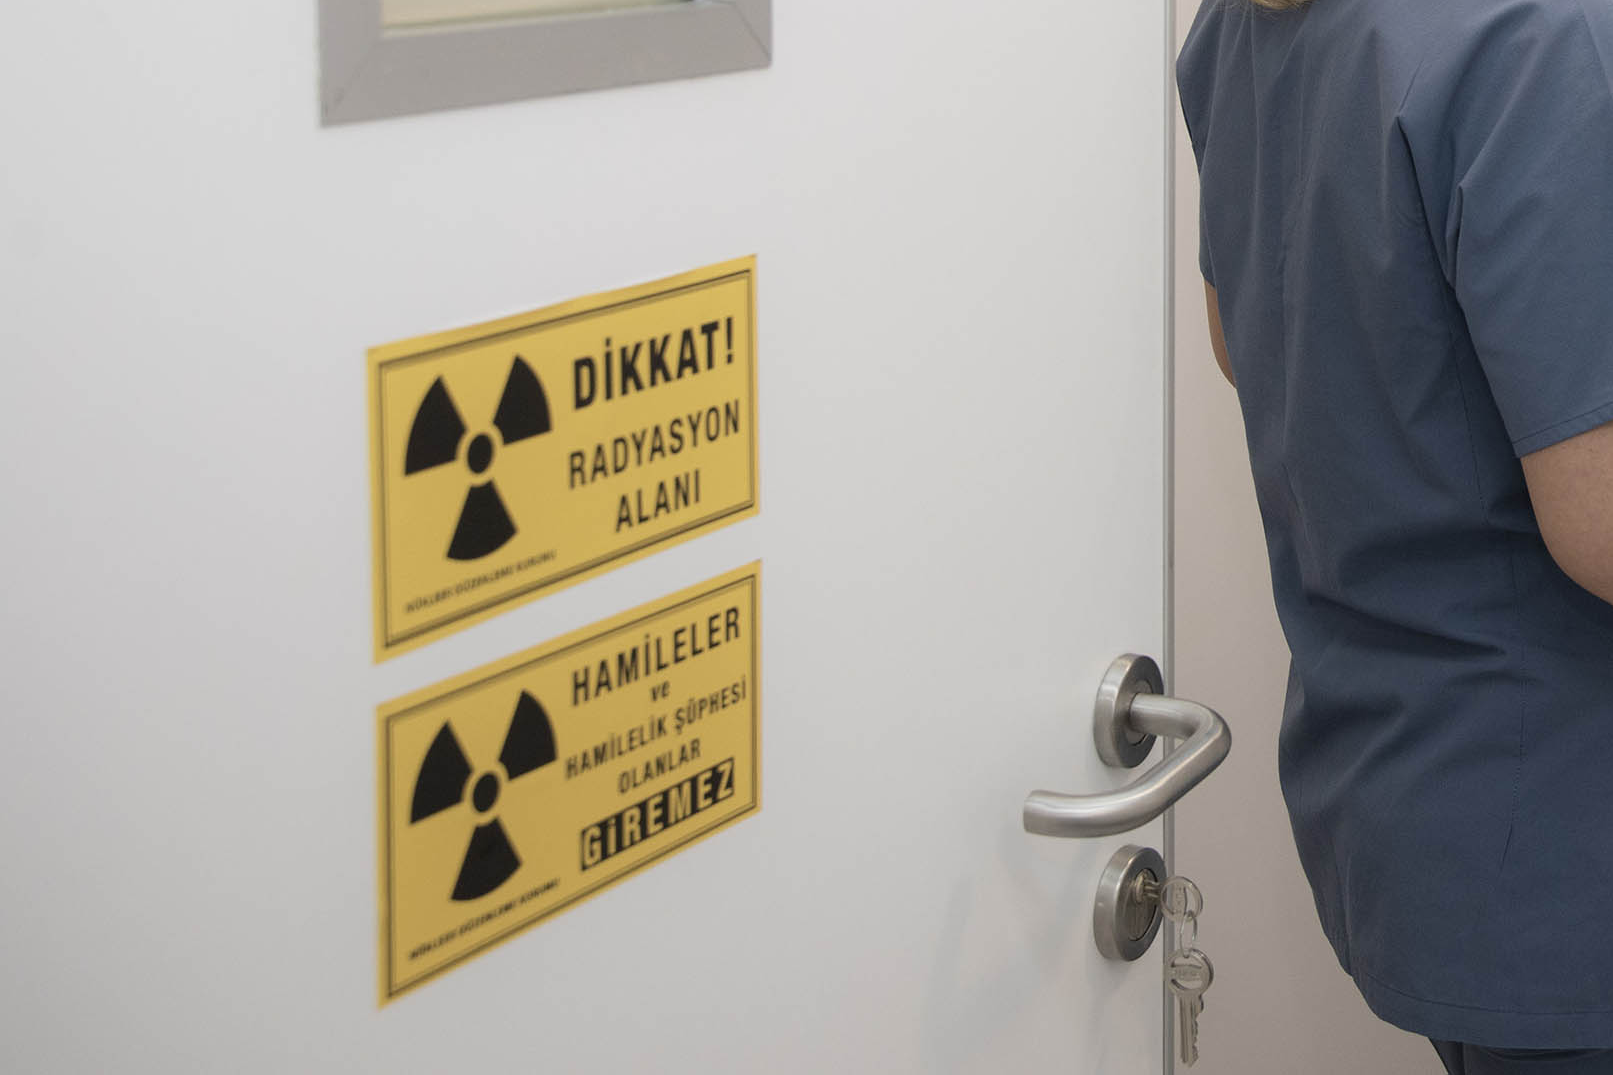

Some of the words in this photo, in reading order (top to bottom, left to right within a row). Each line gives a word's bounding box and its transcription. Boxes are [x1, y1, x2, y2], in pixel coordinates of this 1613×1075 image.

[574, 317, 733, 410] DİKKAT!
[569, 399, 740, 490] RADYASYON
[615, 469, 701, 533] ALANI
[572, 606, 740, 707] HAMİLELER
[650, 680, 671, 702] ve
[565, 716, 667, 780] HAMİLELİK
[674, 674, 747, 735] ŞÜPHESİ
[617, 737, 701, 794] OLANLAR
[581, 760, 735, 869] GİREMEZ
